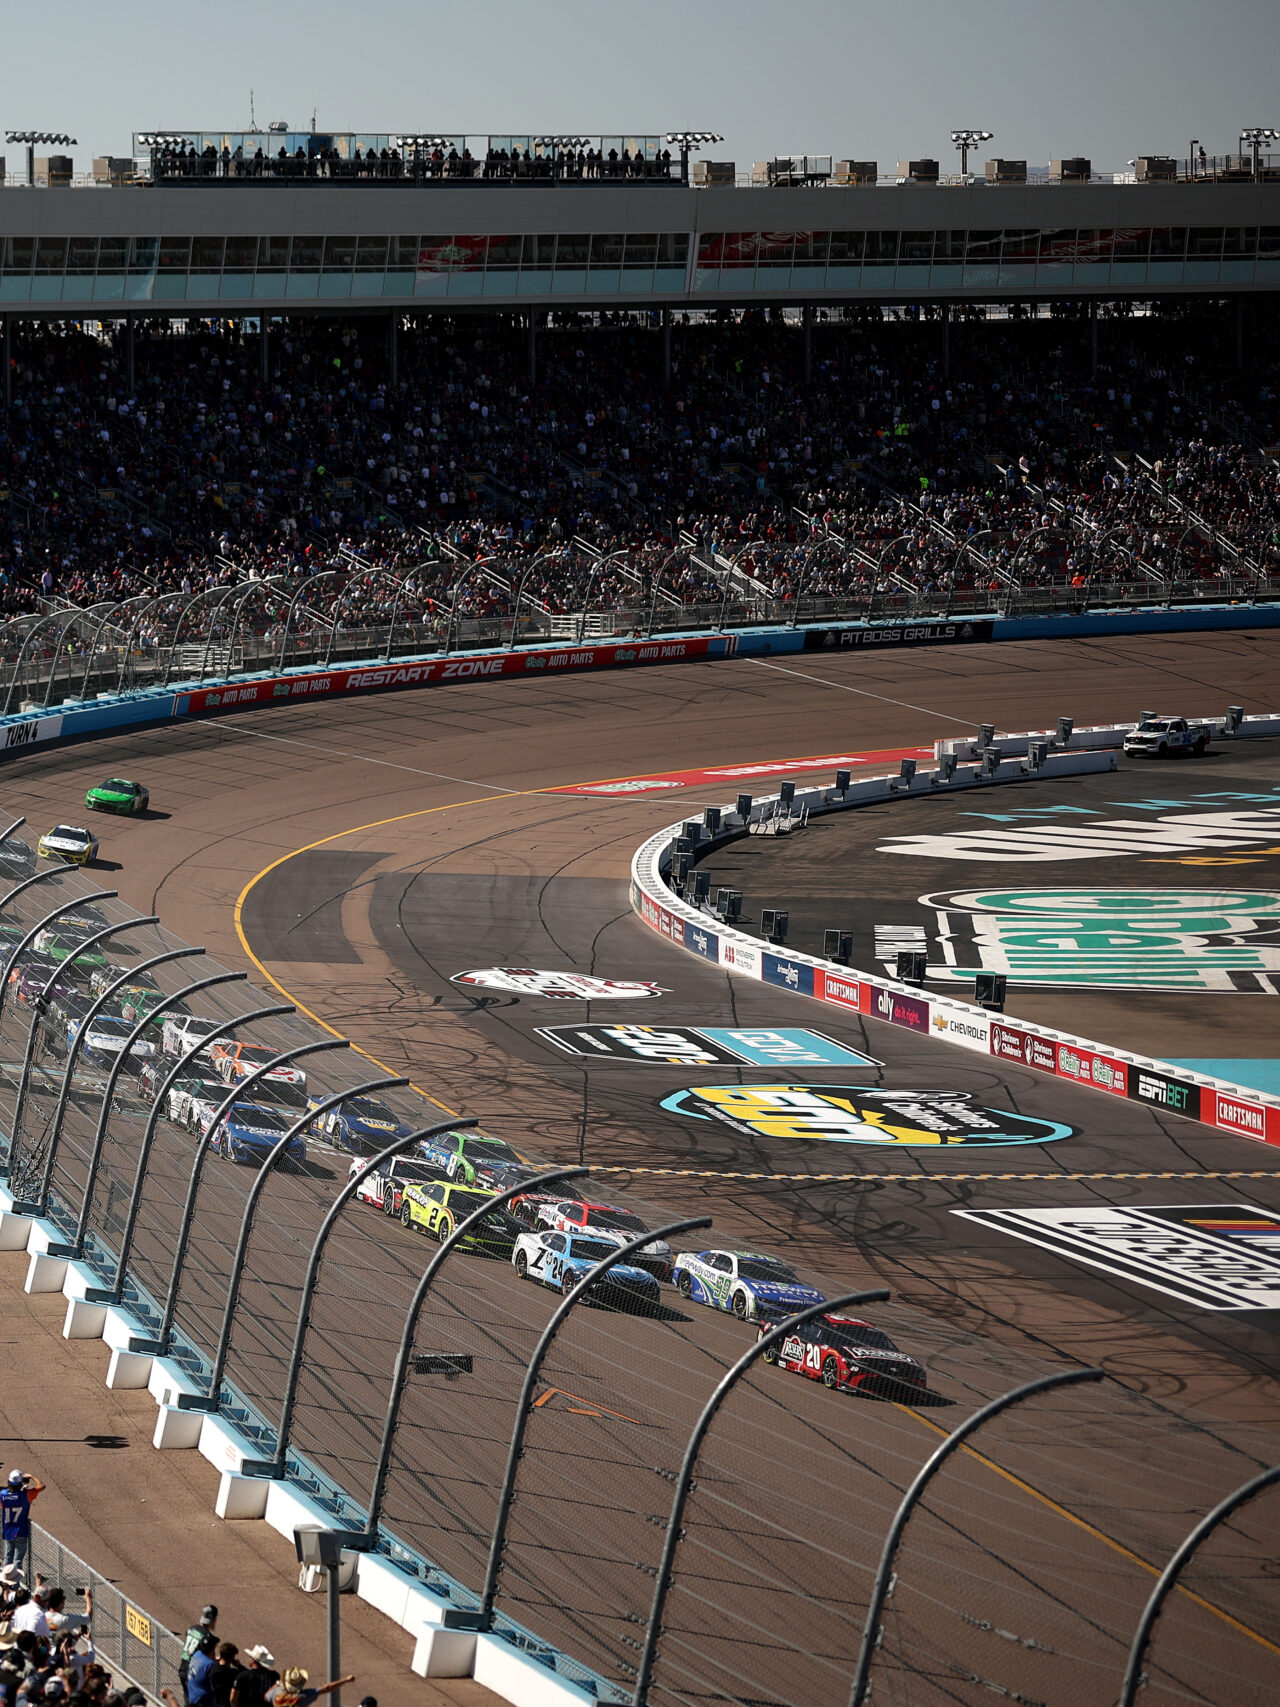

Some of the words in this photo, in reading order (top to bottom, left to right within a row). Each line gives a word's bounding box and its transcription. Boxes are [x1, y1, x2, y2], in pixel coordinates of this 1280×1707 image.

[840, 632, 863, 644] PIT
[863, 630, 901, 643] BOSS
[904, 626, 955, 640] GRILLS
[548, 654, 569, 667] AUTO
[570, 652, 594, 664] PARTS
[638, 647, 660, 659] AUTO
[661, 645, 686, 656] PARTS
[346, 665, 435, 688] RESTART
[441, 659, 505, 677] ZONE
[222, 690, 238, 703] AUTO
[238, 687, 258, 701] PARTS
[291, 682, 309, 694] AUTO
[309, 678, 331, 691] PARTS
[5, 722, 32, 747] TURN
[31, 721, 39, 741] 4
[875, 807, 1280, 861] SHIP
[873, 924, 927, 940] AUTO
[945, 888, 1280, 988] O'Reilly
[725, 945, 734, 963] ABB
[827, 980, 858, 1001] CRAFTSMAN
[877, 990, 893, 1021] ally
[894, 1006, 902, 1018] do
[902, 1007, 906, 1019] it
[950, 1020, 987, 1041] CHEVROLET
[1002, 1031, 1020, 1045] Shriners
[727, 1031, 831, 1063] GOVX
[1034, 1041, 1053, 1056] Shriners
[1059, 1047, 1081, 1078] O'Reilly
[1092, 1057, 1114, 1089] O'Reilly
[1138, 1074, 1167, 1103] ESPN
[1167, 1083, 1189, 1109] BET
[326, 1113, 335, 1133] 9
[688, 1087, 898, 1141] 500
[1219, 1102, 1263, 1130] CRAFTSMAN
[446, 1154, 458, 1177] 8
[429, 1207, 439, 1228] 2
[1057, 1221, 1192, 1246] CUP
[552, 1257, 564, 1282] 24
[806, 1343, 820, 1370] 20
[5, 1507, 23, 1524] 17
[128, 1610, 137, 1631] 157
